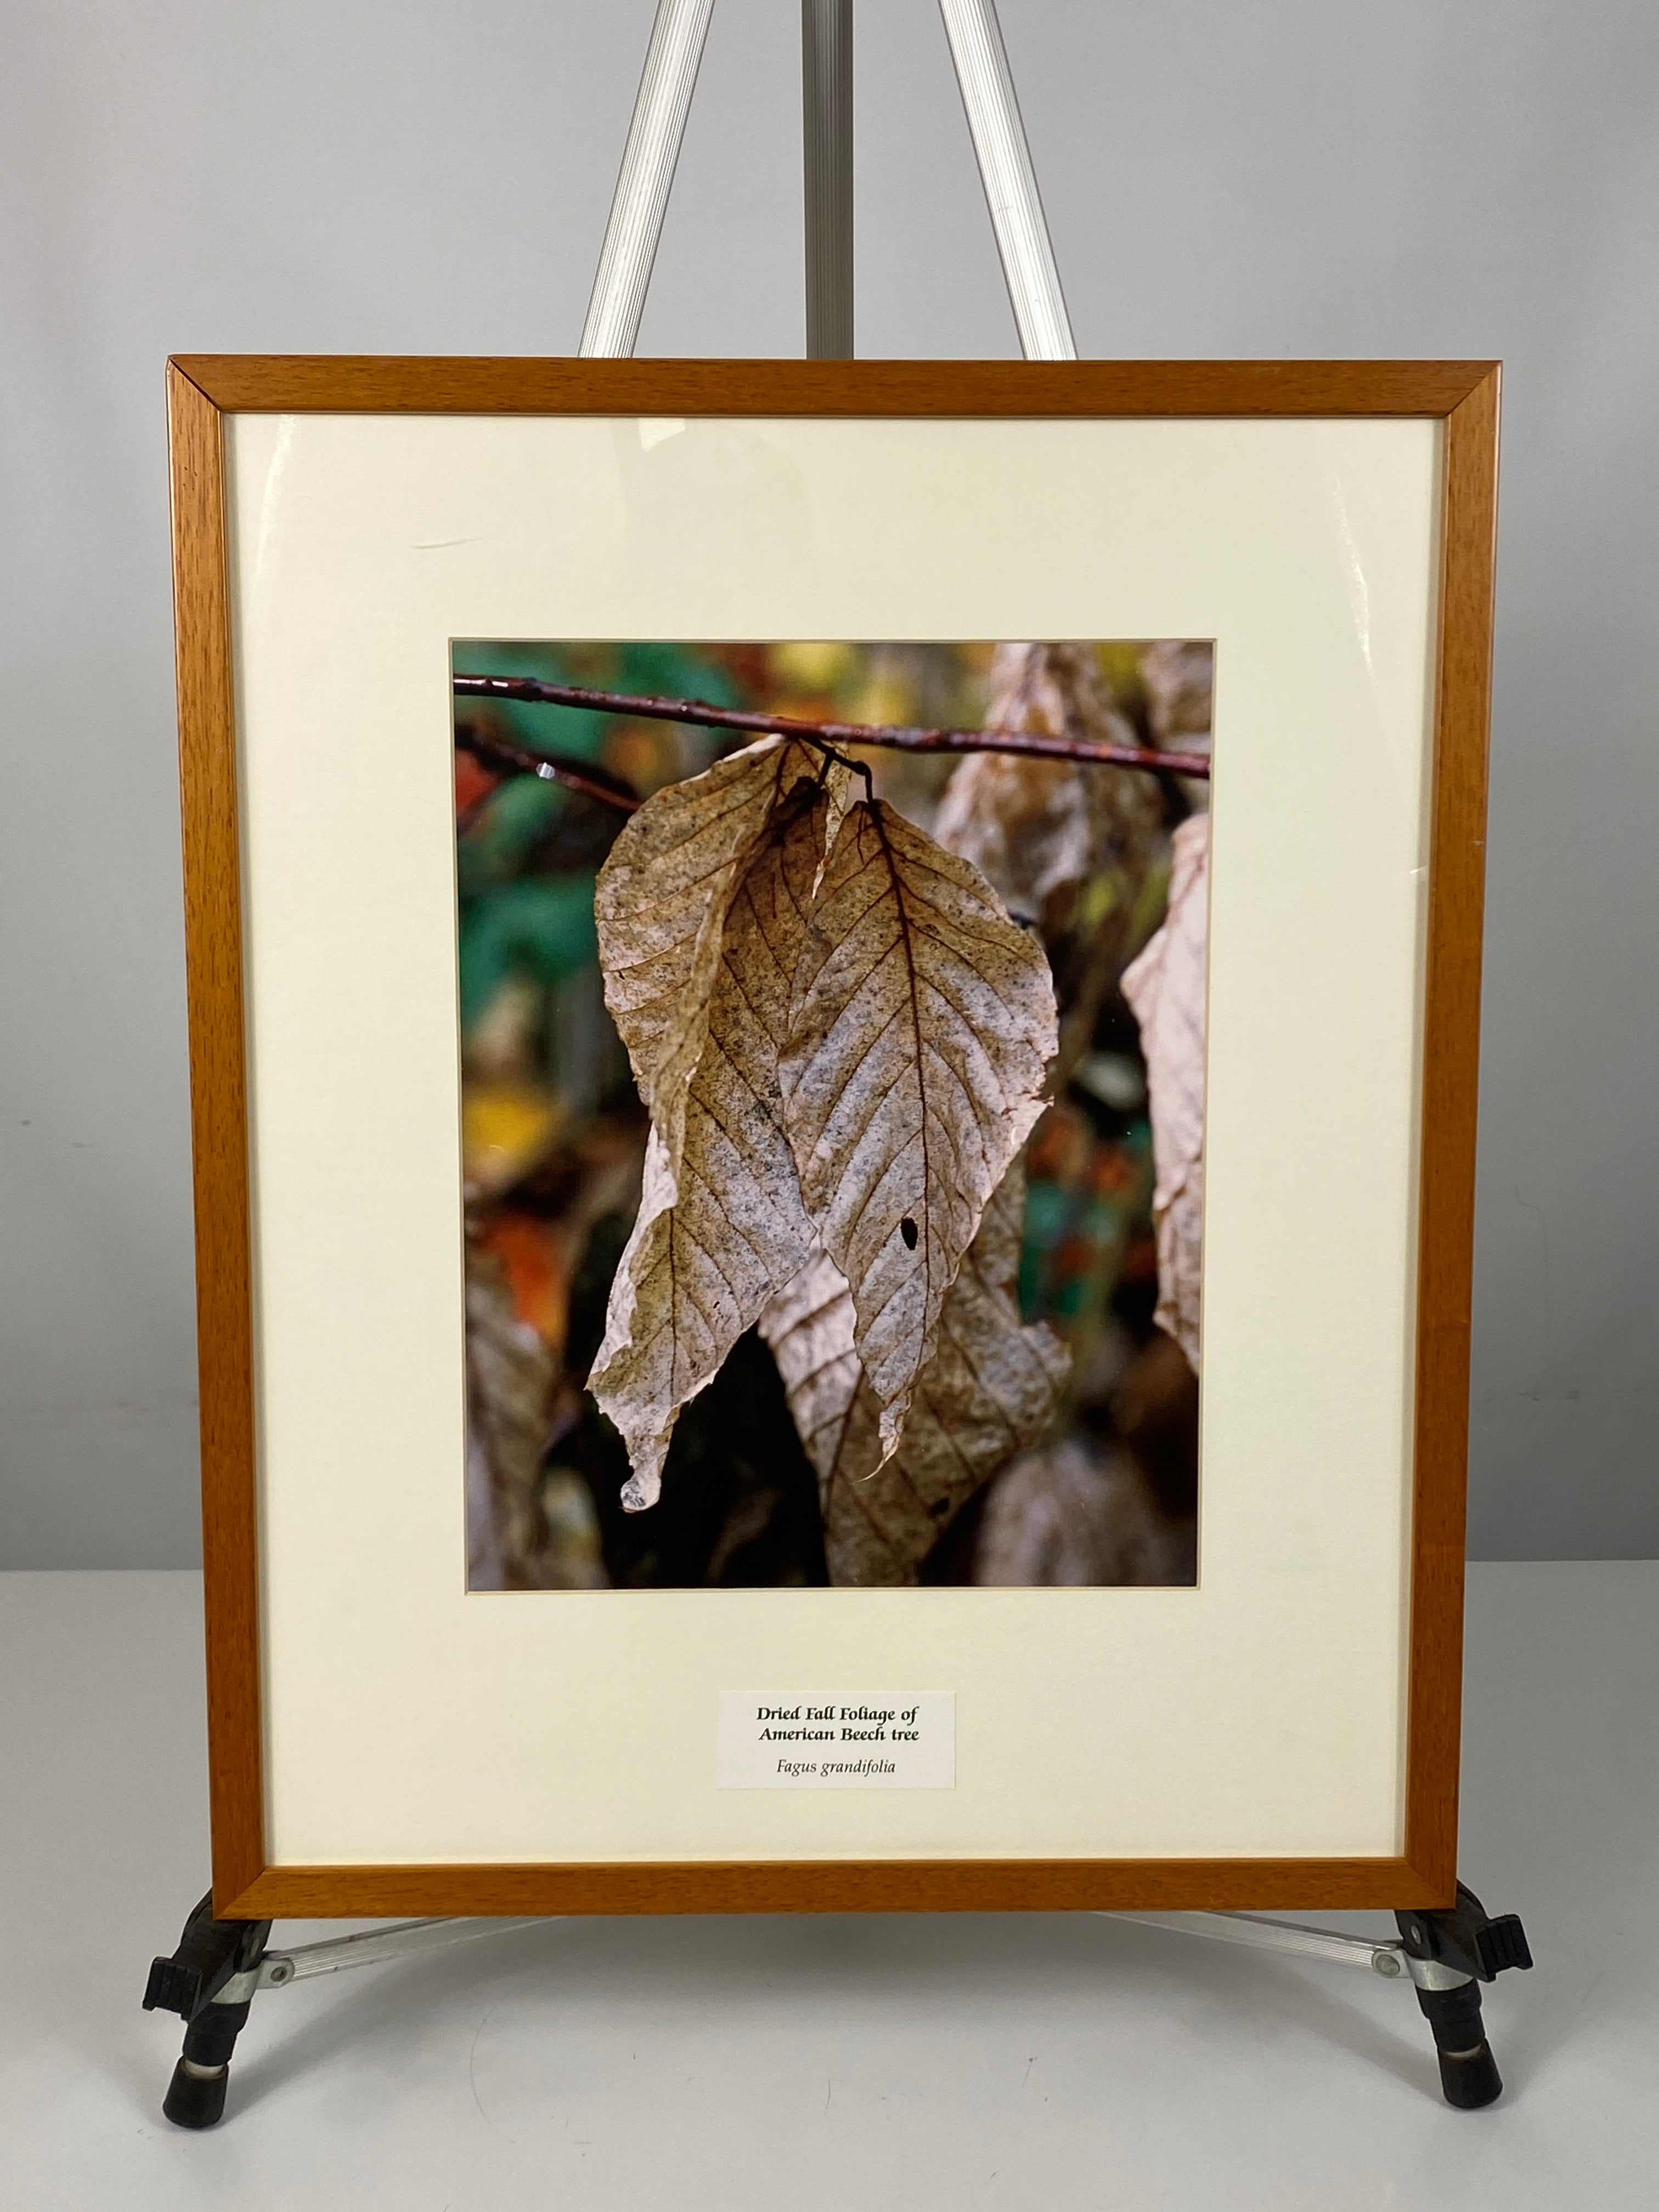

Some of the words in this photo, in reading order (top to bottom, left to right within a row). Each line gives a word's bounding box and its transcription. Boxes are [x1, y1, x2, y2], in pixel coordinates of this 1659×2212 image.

[757, 1706, 802, 1720] Dried
[805, 1706, 837, 1720] Fall
[839, 1706, 896, 1726] Foliage
[901, 1706, 921, 1726] of
[758, 1727, 836, 1741] American
[840, 1726, 887, 1741] Beech
[891, 1729, 920, 1741] tree
[777, 1759, 817, 1776] Fagus
[820, 1759, 896, 1777] grandifolia
